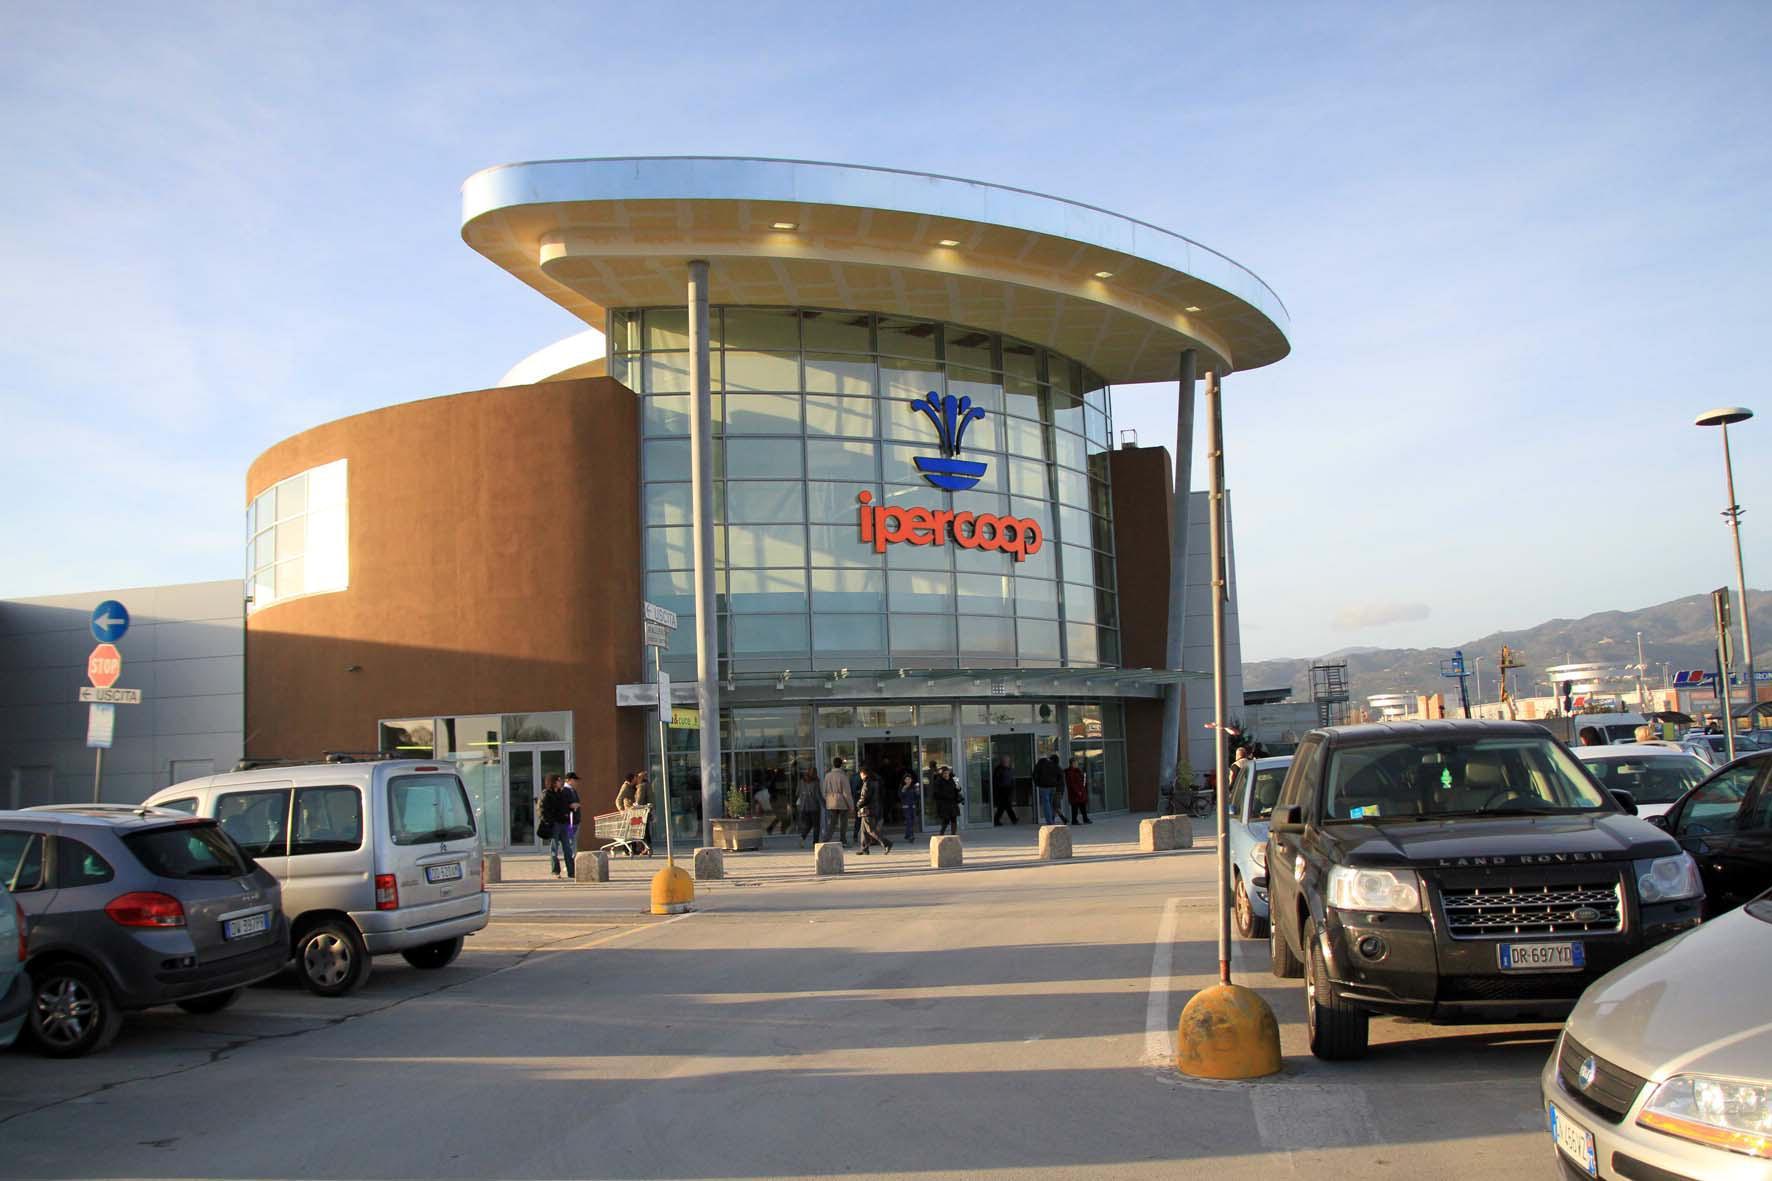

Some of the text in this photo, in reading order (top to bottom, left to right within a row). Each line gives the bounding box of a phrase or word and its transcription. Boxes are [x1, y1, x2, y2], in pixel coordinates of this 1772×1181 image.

[858, 490, 1043, 562] ipercoop
[91, 658, 118, 675] STOP
[95, 689, 138, 702] USCITA
[1439, 852, 1604, 867] LAND ROVER
